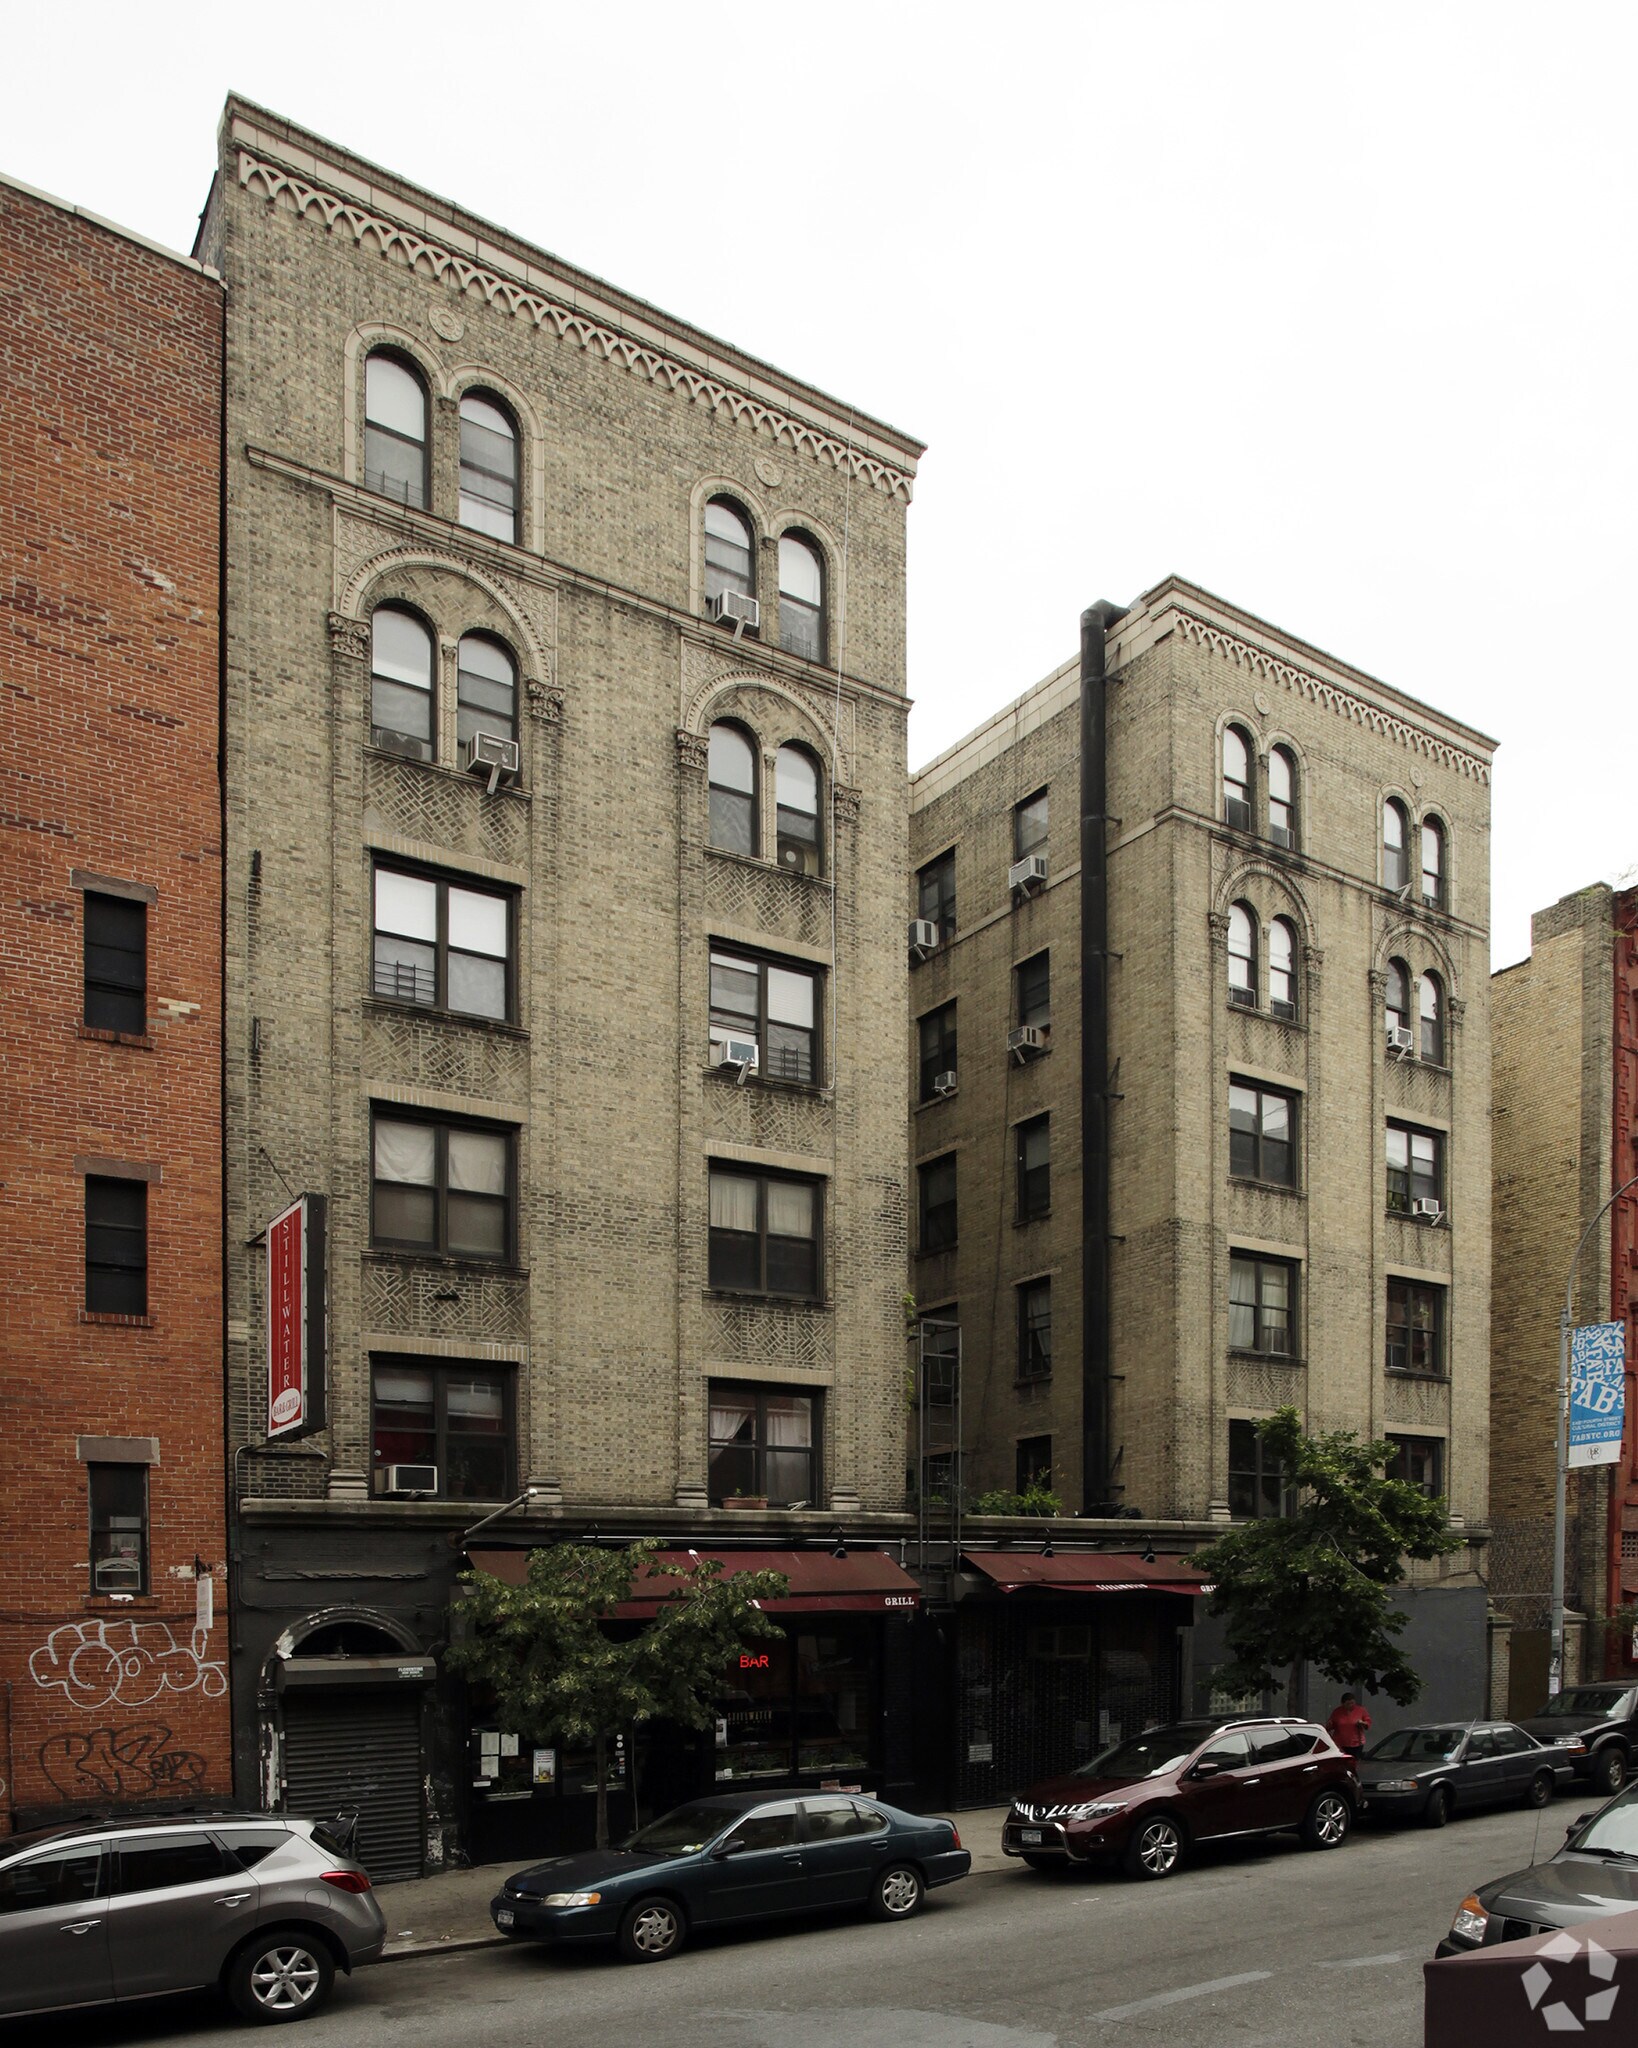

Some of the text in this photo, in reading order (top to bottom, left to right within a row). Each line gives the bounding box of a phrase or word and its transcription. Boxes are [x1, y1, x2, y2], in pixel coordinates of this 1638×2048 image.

[282, 1219, 291, 1388] STILLWATER
[1571, 1377, 1618, 1413] FAB
[885, 1597, 914, 1606] GRILL
[740, 1656, 769, 1668] BAR
